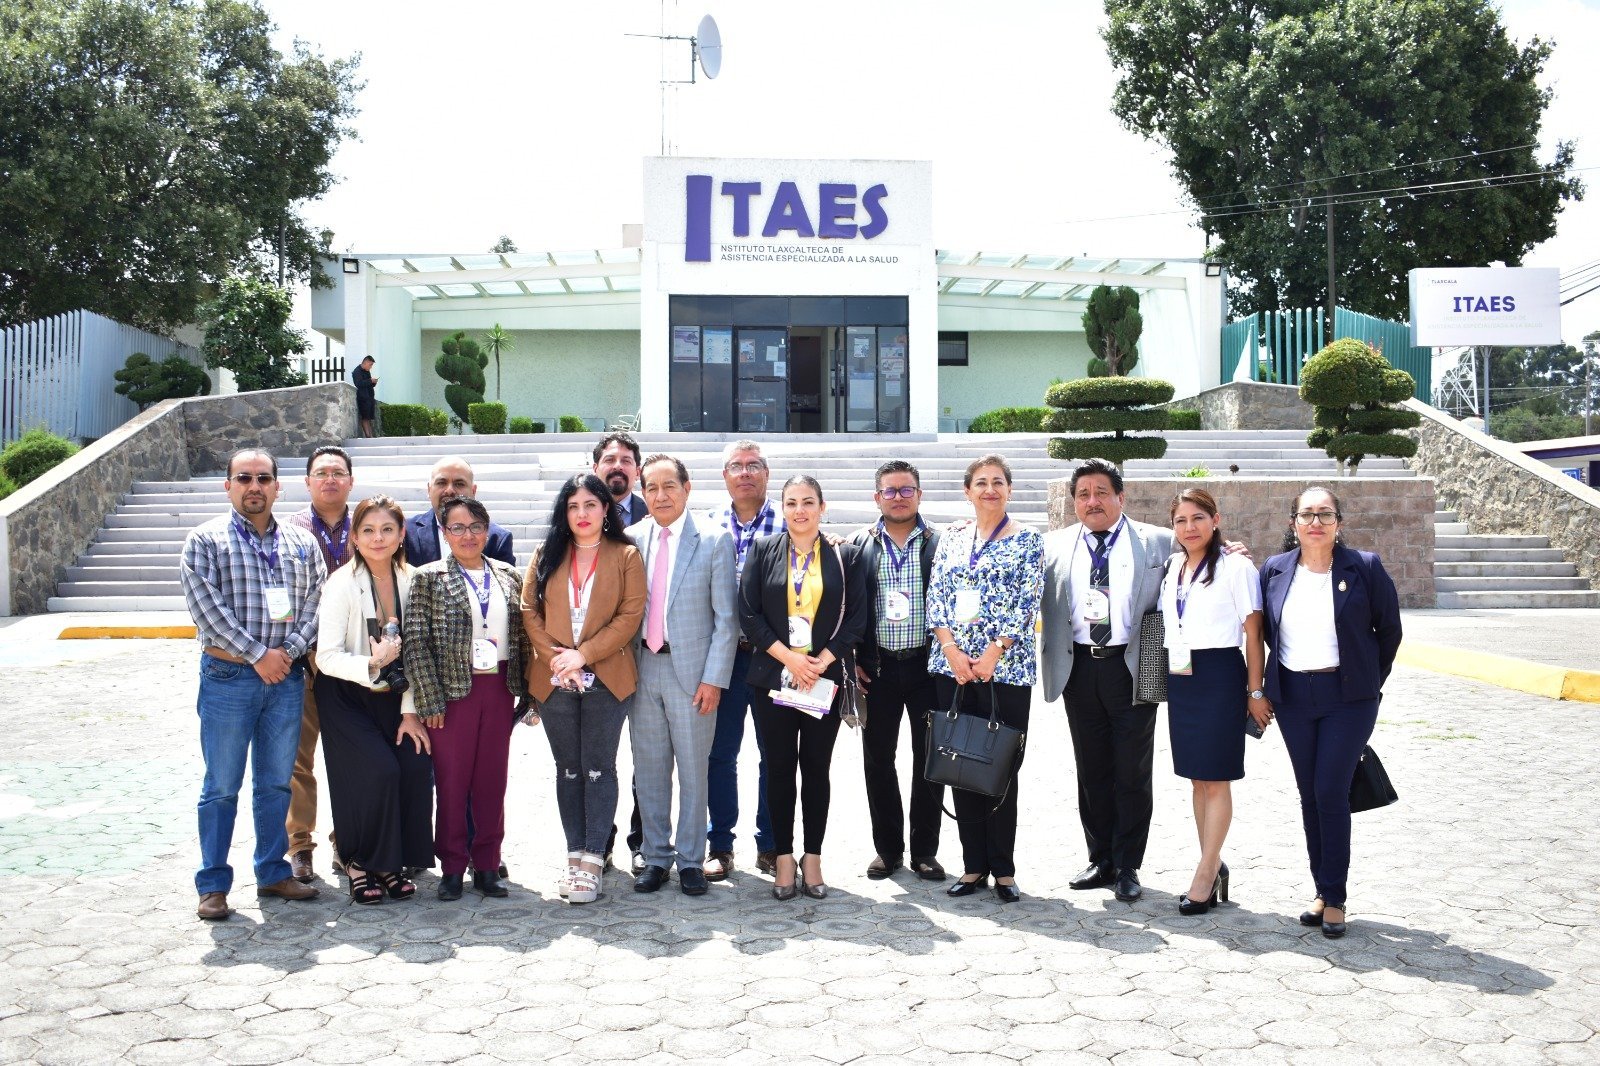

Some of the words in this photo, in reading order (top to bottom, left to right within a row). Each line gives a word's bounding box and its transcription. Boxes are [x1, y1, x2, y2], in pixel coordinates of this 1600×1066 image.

[685, 175, 889, 262] ITAES
[767, 245, 830, 254] TLAXCALTECA
[831, 246, 844, 254] DE
[720, 253, 774, 262] ASISTENCIA
[775, 254, 846, 263] ESPECIALIZADA
[847, 255, 854, 263] A
[855, 255, 867, 263] LA
[868, 255, 899, 264] SALUD
[1453, 295, 1516, 313] ITAES
